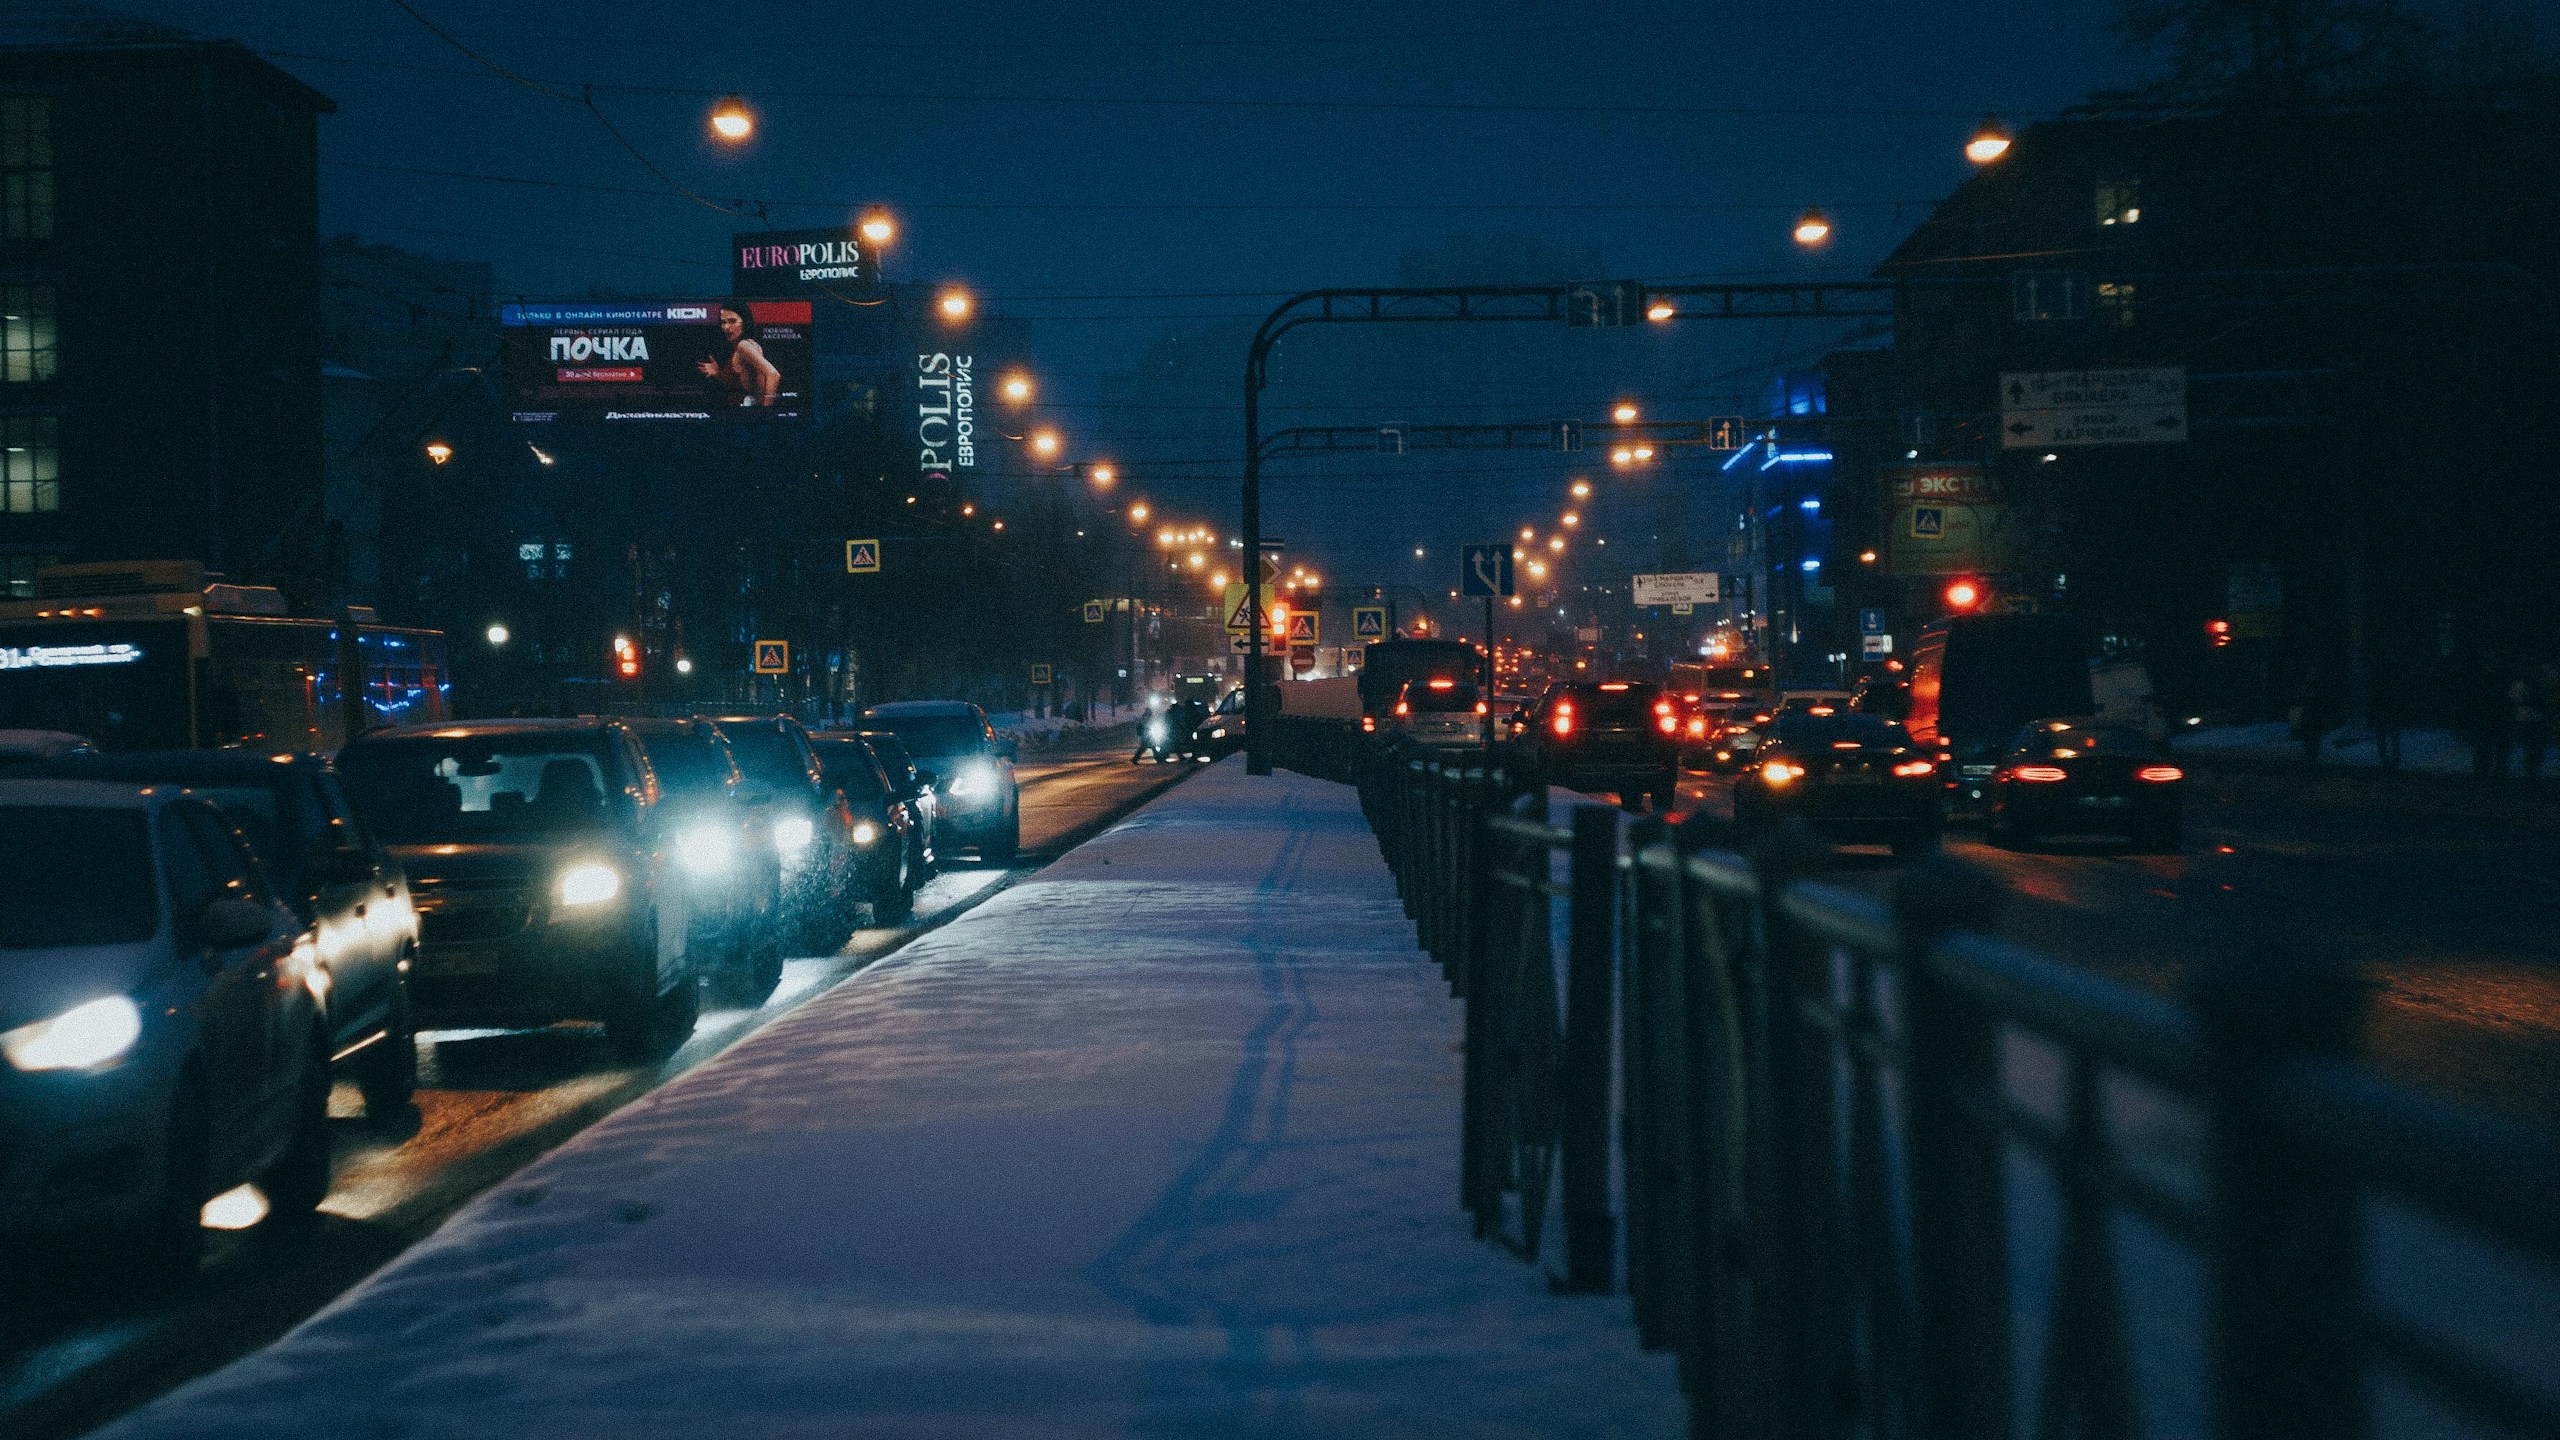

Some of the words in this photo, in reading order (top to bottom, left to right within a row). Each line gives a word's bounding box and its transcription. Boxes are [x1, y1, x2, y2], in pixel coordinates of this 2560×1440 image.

[741, 241, 860, 269] EUROPOLIS
[564, 310, 603, 319] ОНЛАЙН
[605, 310, 662, 319] КИНОТЕАТРЕ
[666, 307, 707, 320] KION
[550, 336, 650, 361] ПОЧКА
[955, 354, 975, 467] ЕВРОПОЛИС
